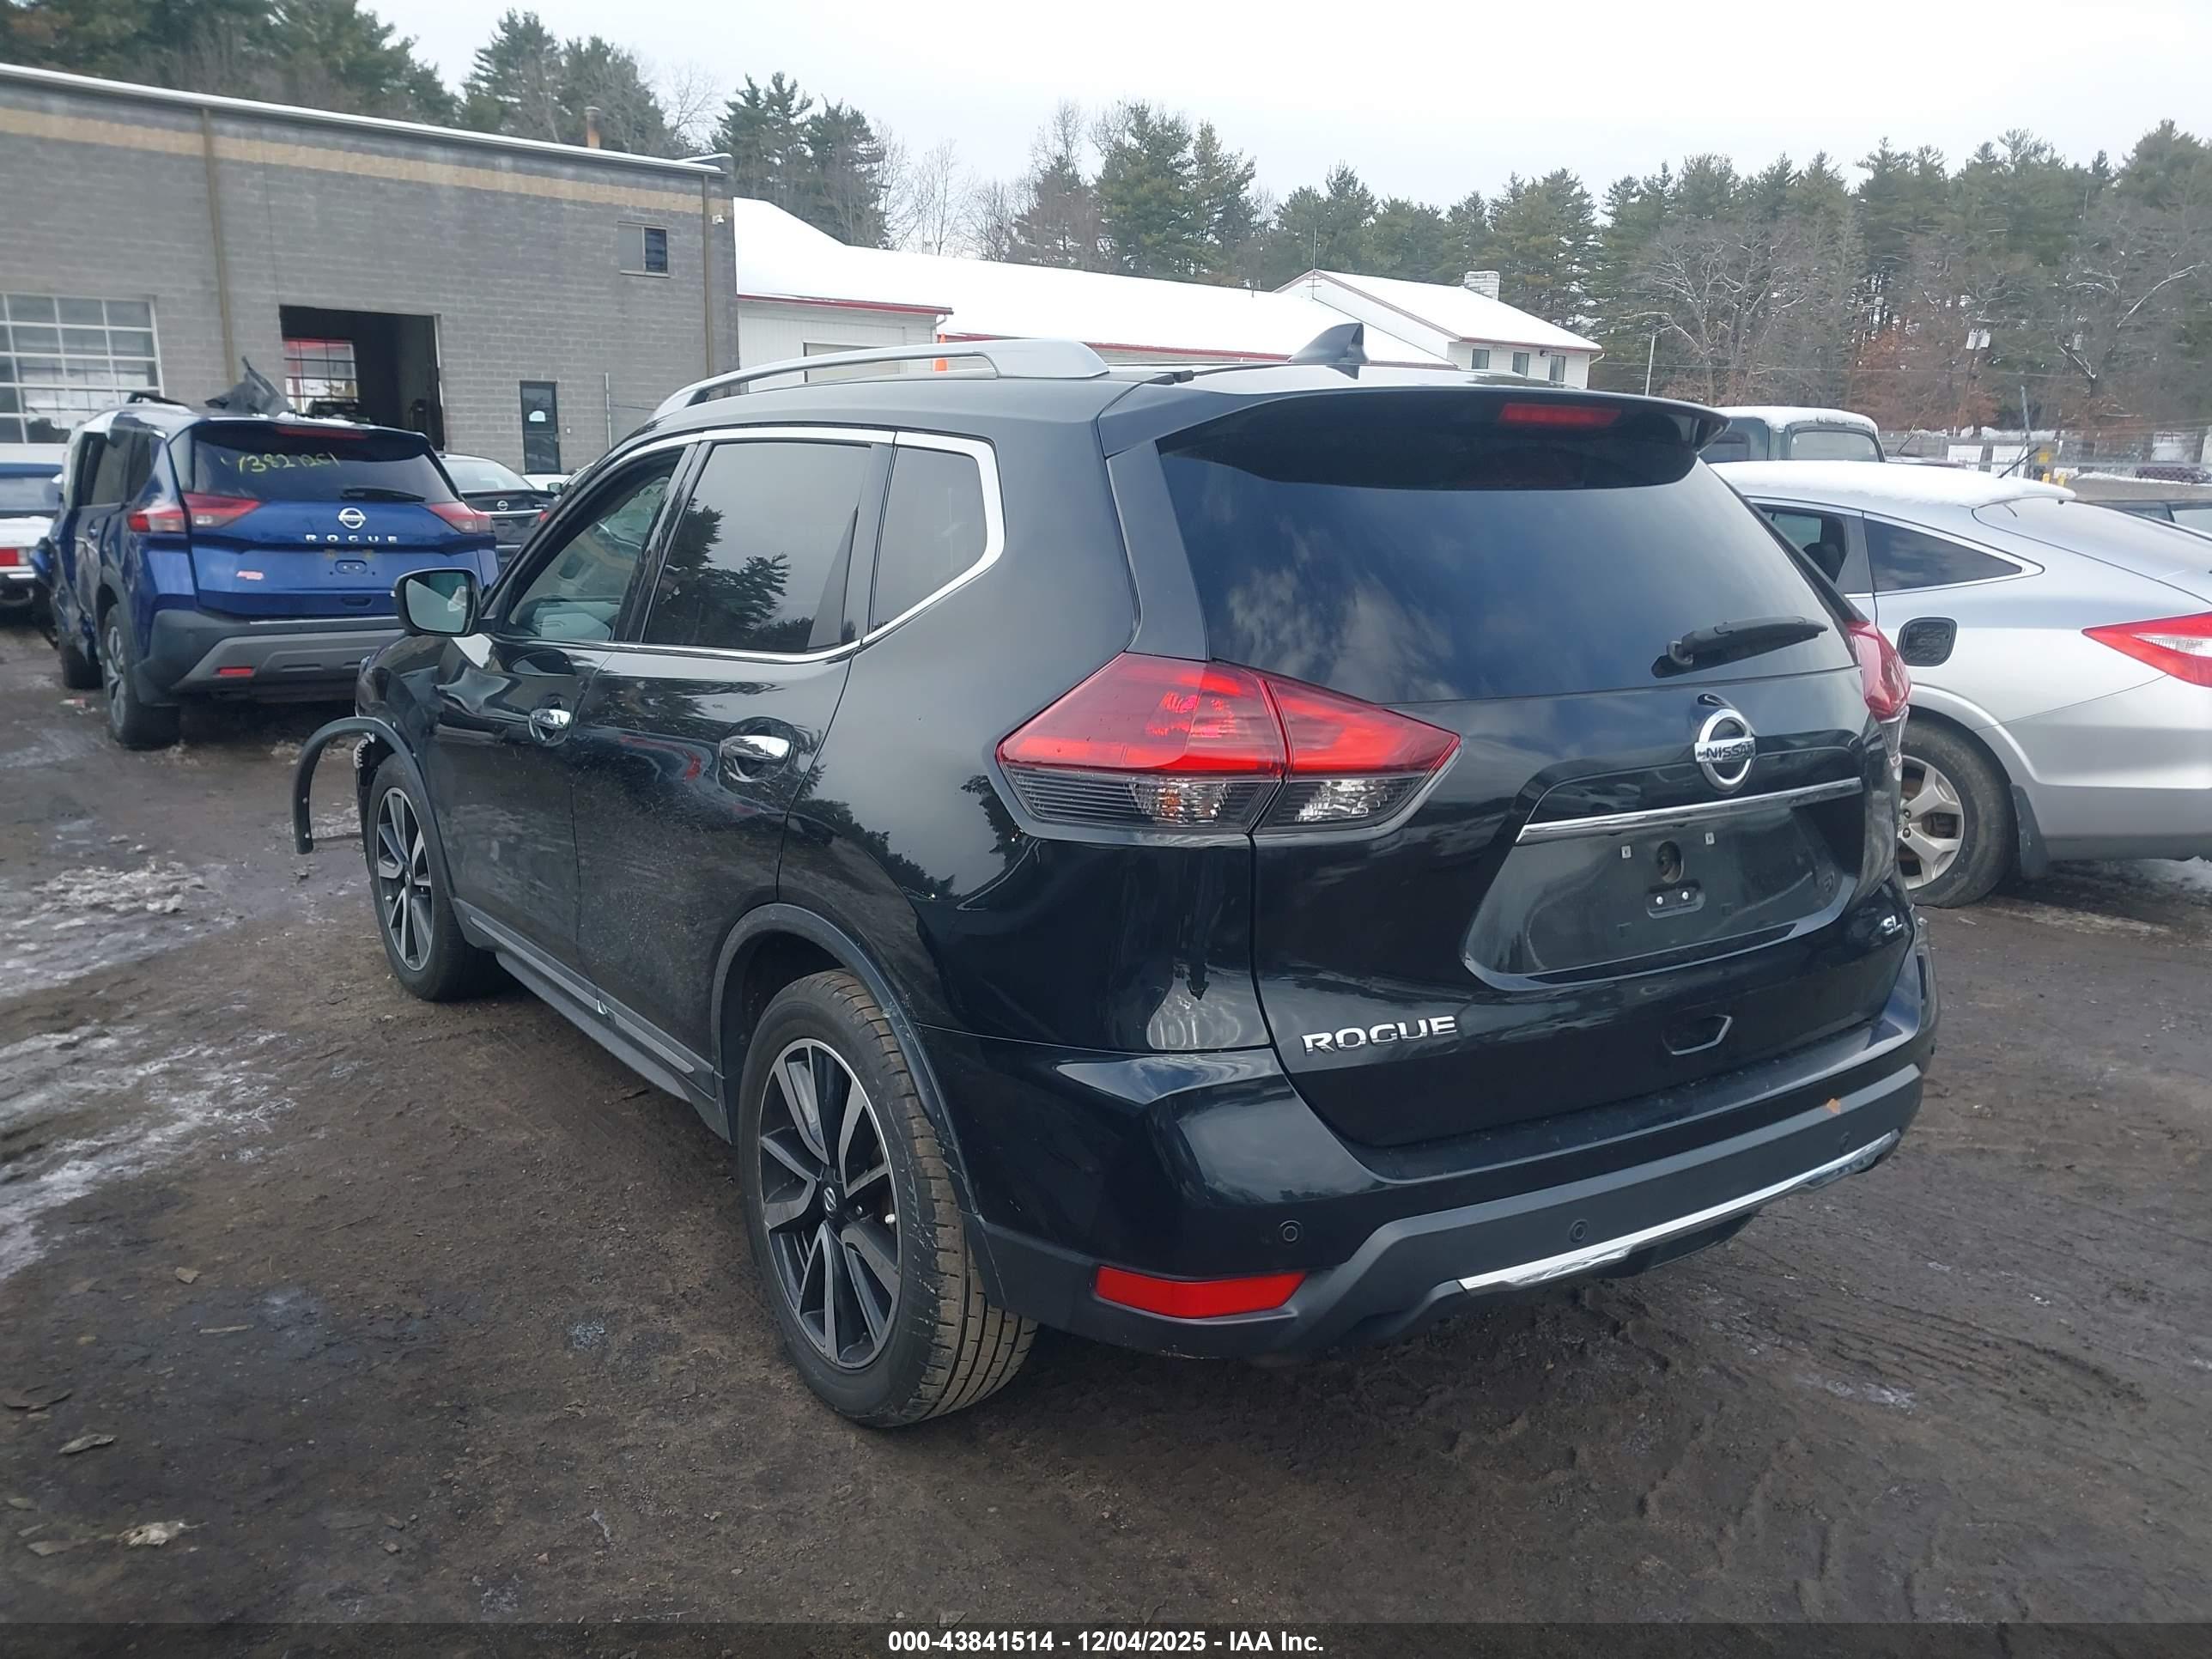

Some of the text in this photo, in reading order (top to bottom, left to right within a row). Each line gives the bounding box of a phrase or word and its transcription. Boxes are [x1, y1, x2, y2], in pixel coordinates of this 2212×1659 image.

[306, 534, 398, 543] ROGUE
[1706, 742, 1754, 758] NISSAN
[1882, 915, 1903, 935] SL
[1301, 1015, 1457, 1055] ROGUE
